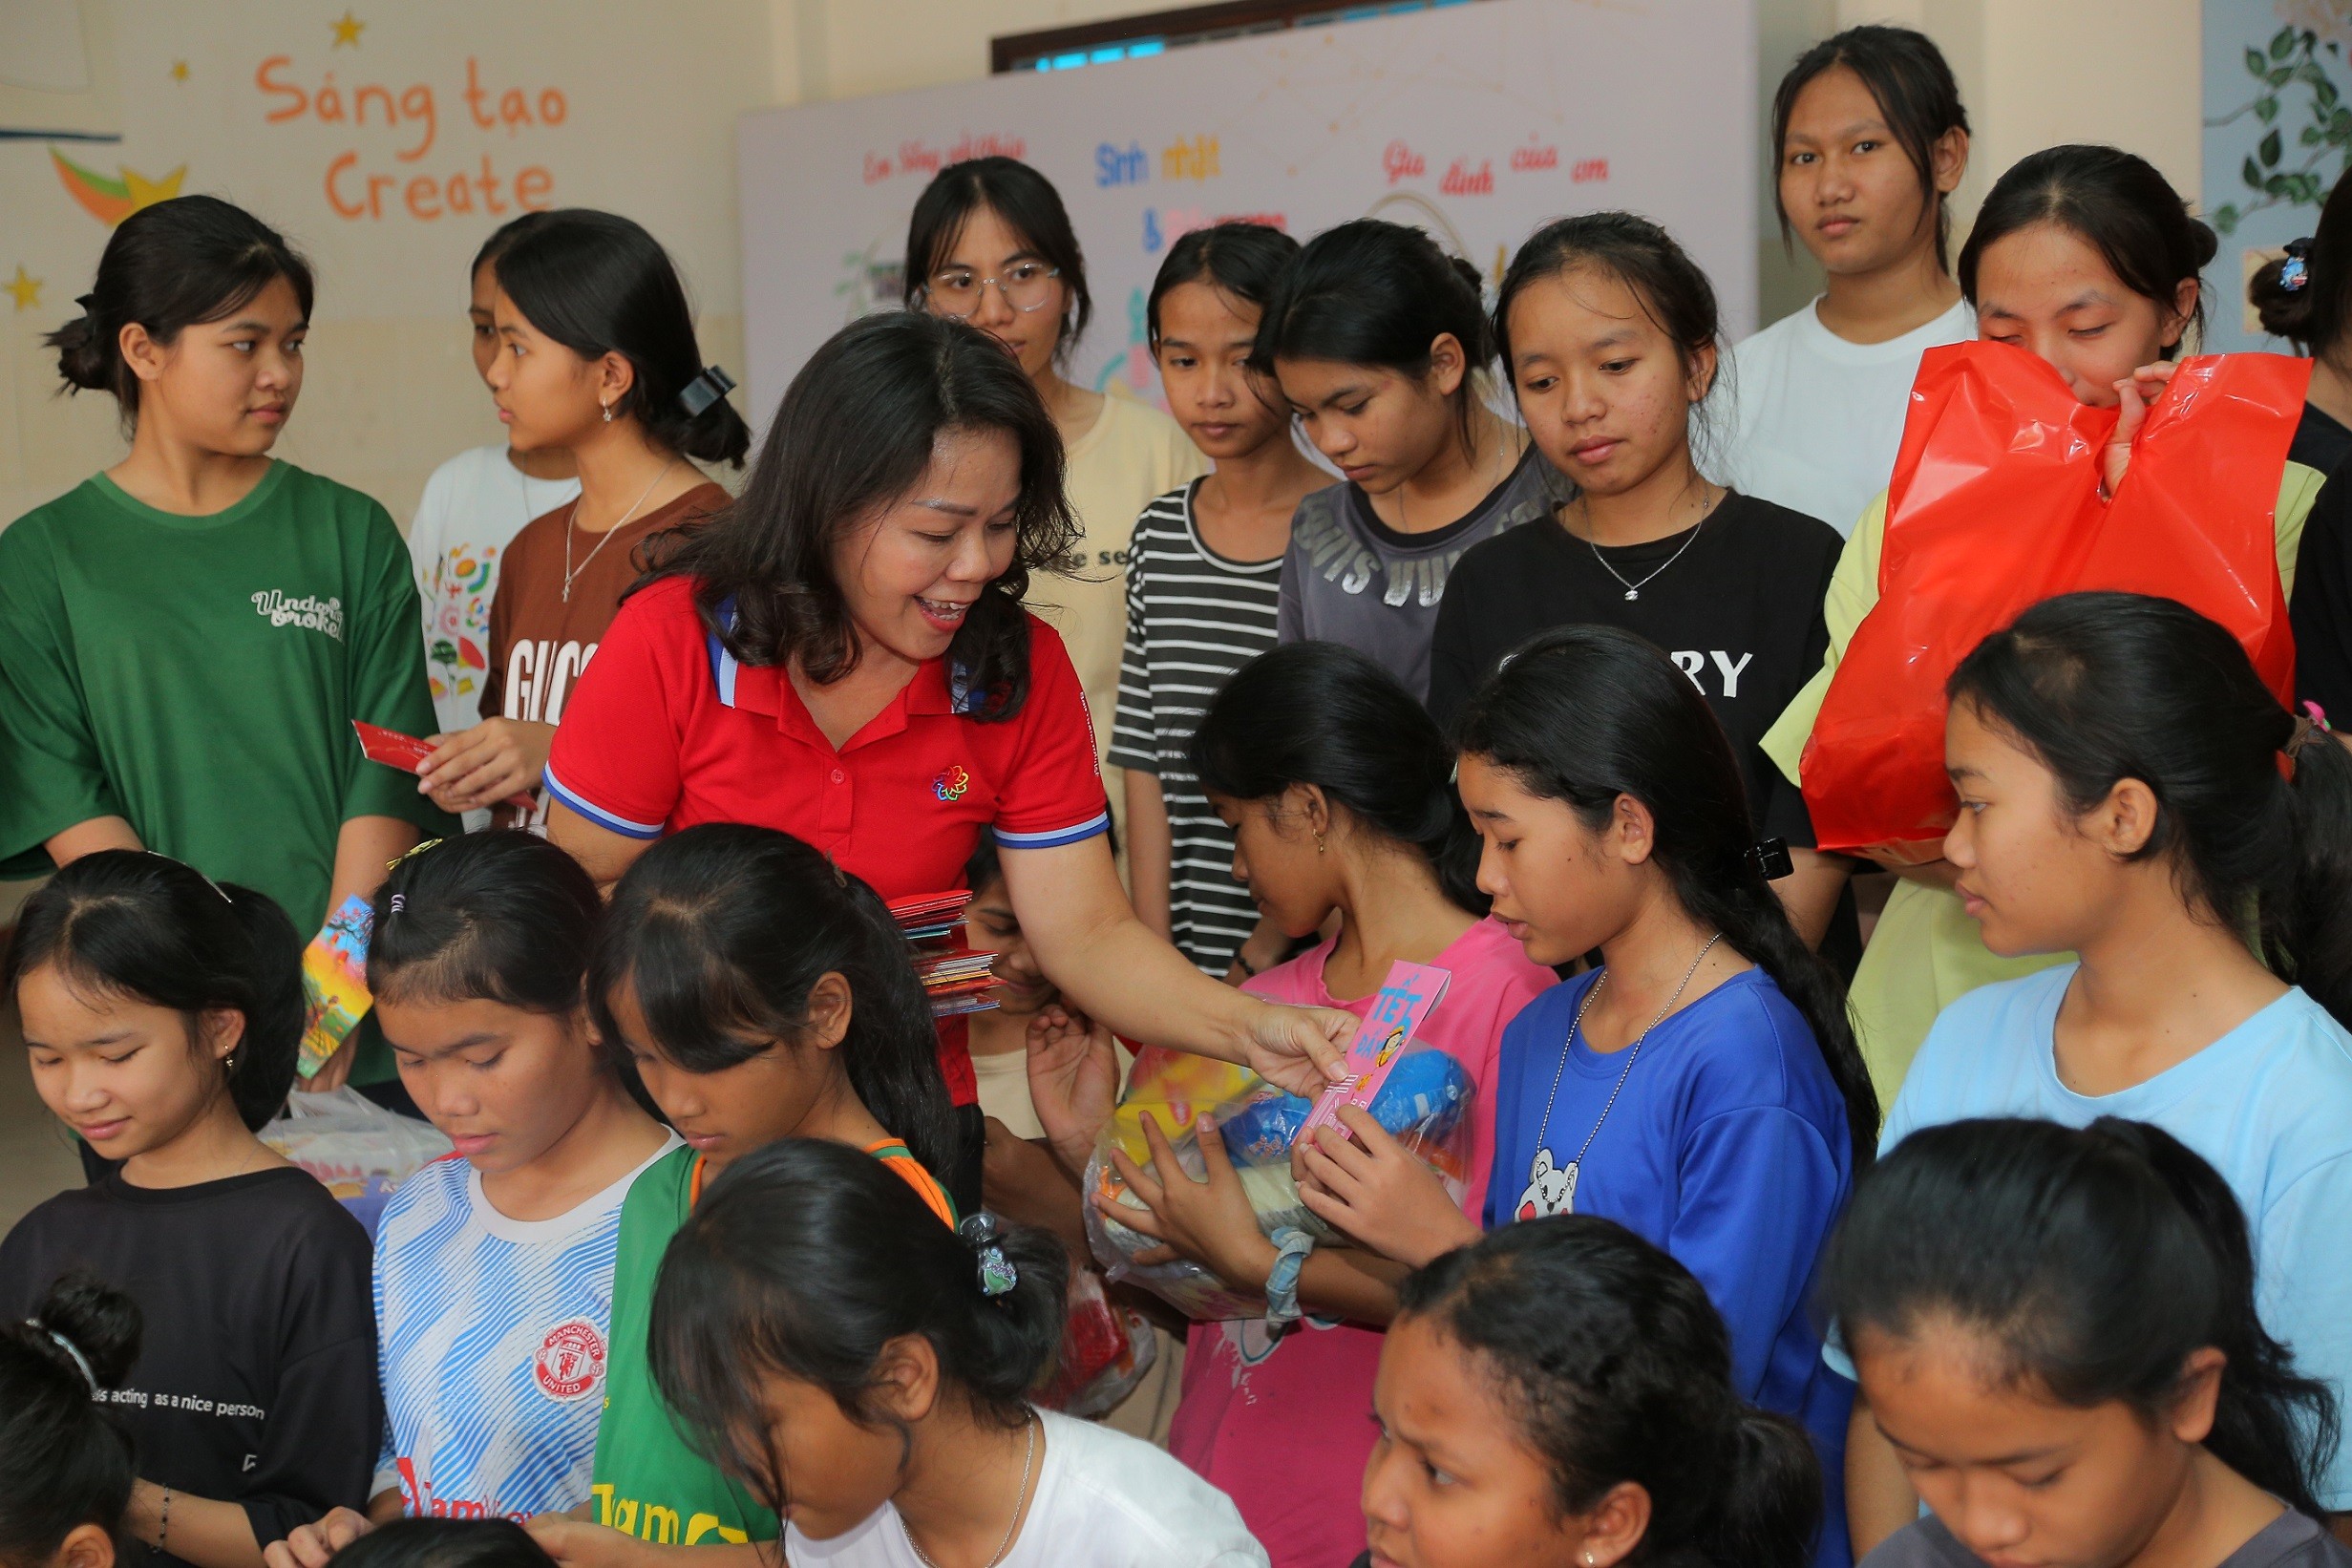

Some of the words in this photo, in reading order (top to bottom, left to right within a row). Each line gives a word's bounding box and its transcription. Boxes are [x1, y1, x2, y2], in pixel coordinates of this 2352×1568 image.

[255, 54, 435, 162] Sáng
[464, 55, 567, 138] tạo
[325, 151, 555, 221] Create
[548, 1325, 601, 1357] MANCHESTER
[542, 1374, 581, 1393] UNITED
[111, 1388, 148, 1409] acting
[154, 1393, 169, 1406] as
[171, 1395, 180, 1408] a
[180, 1394, 213, 1411] nice
[216, 1402, 265, 1420] person
